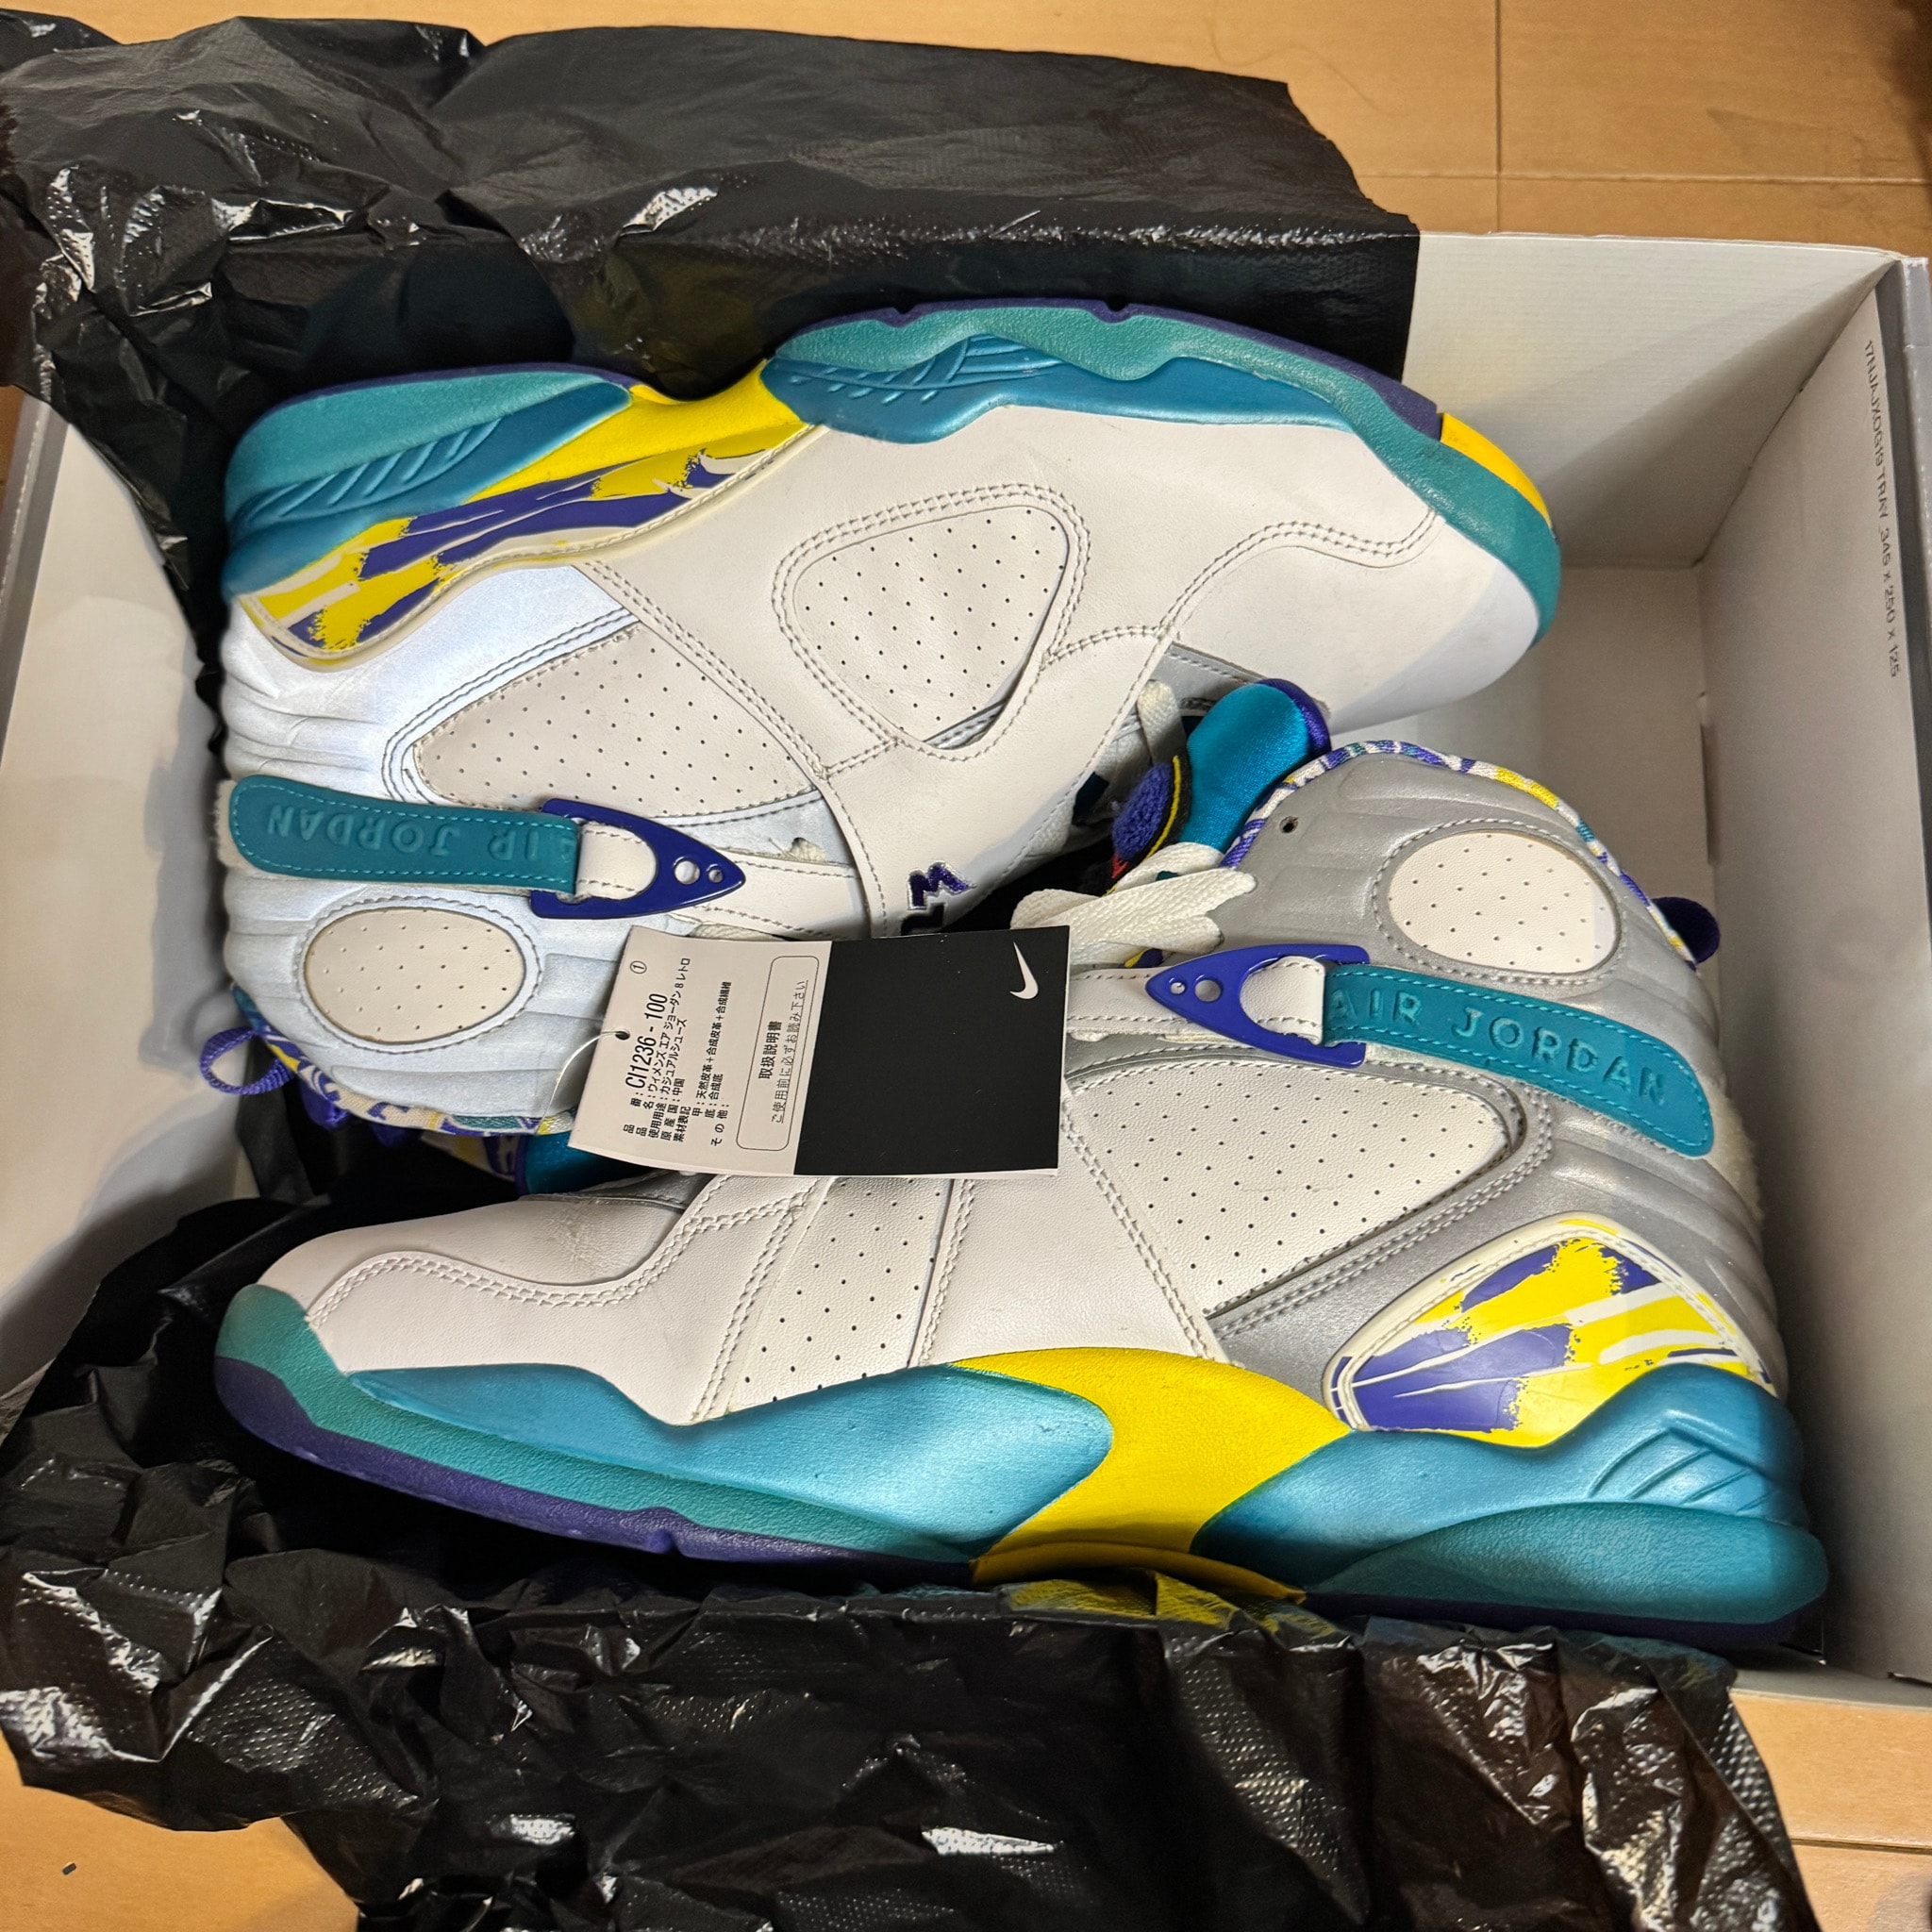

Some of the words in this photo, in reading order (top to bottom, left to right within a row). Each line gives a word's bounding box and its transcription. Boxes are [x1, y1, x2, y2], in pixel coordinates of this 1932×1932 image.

[1876, 466, 1889, 519] TRAY
[1885, 585, 1895, 624] 250
[1889, 644, 1901, 677] 125
[268, 805, 460, 856] JORDAN
[758, 1021, 782, 1079] 取扱説明書
[771, 980, 808, 1124] ご使用前に必ずお読み下さい
[1326, 989, 1422, 1025] AIR
[1452, 1007, 1664, 1107] JORDAN
